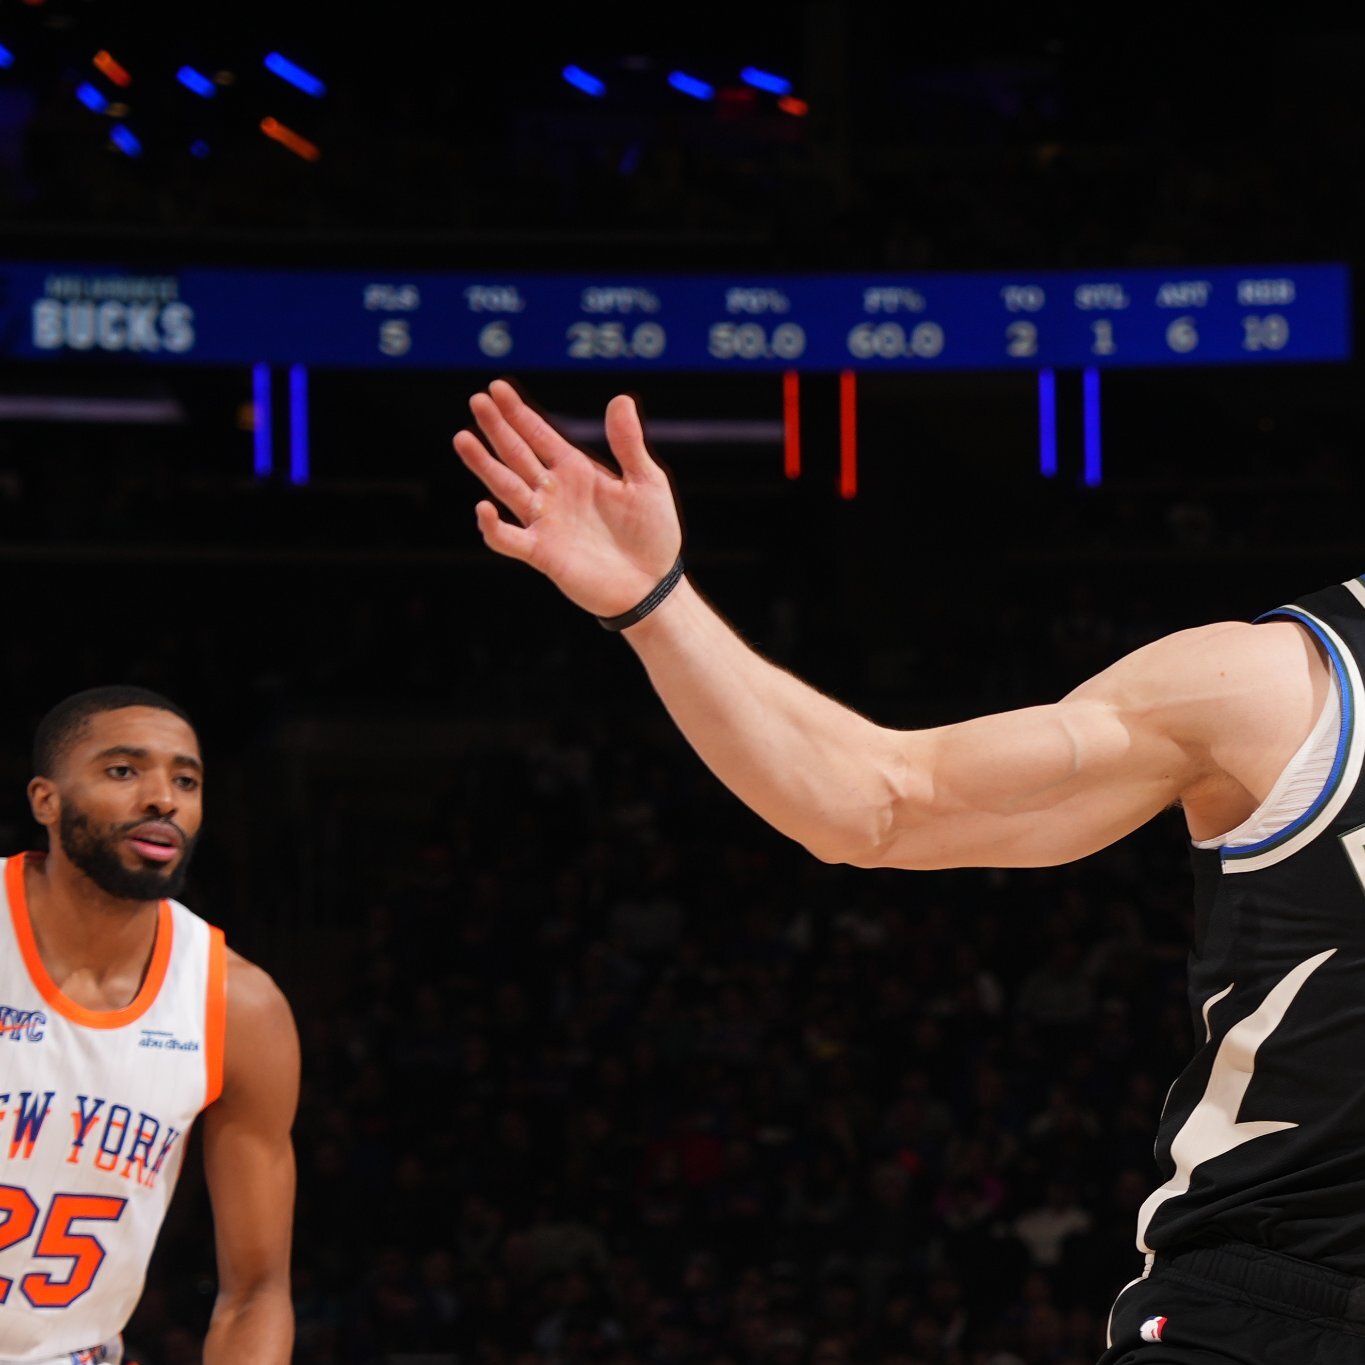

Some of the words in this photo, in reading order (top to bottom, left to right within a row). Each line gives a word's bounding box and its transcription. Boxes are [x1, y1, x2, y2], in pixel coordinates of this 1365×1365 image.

[33, 300, 194, 351] BUCKS
[379, 319, 411, 356] 5
[478, 320, 512, 357] 6
[566, 321, 666, 358] 25.0
[708, 321, 805, 359] 50.0
[848, 321, 944, 358] 60.0
[1006, 320, 1038, 357] 2
[1090, 318, 1117, 356] 1
[1165, 315, 1198, 353] 6
[67, 1094, 180, 1188] YORK
